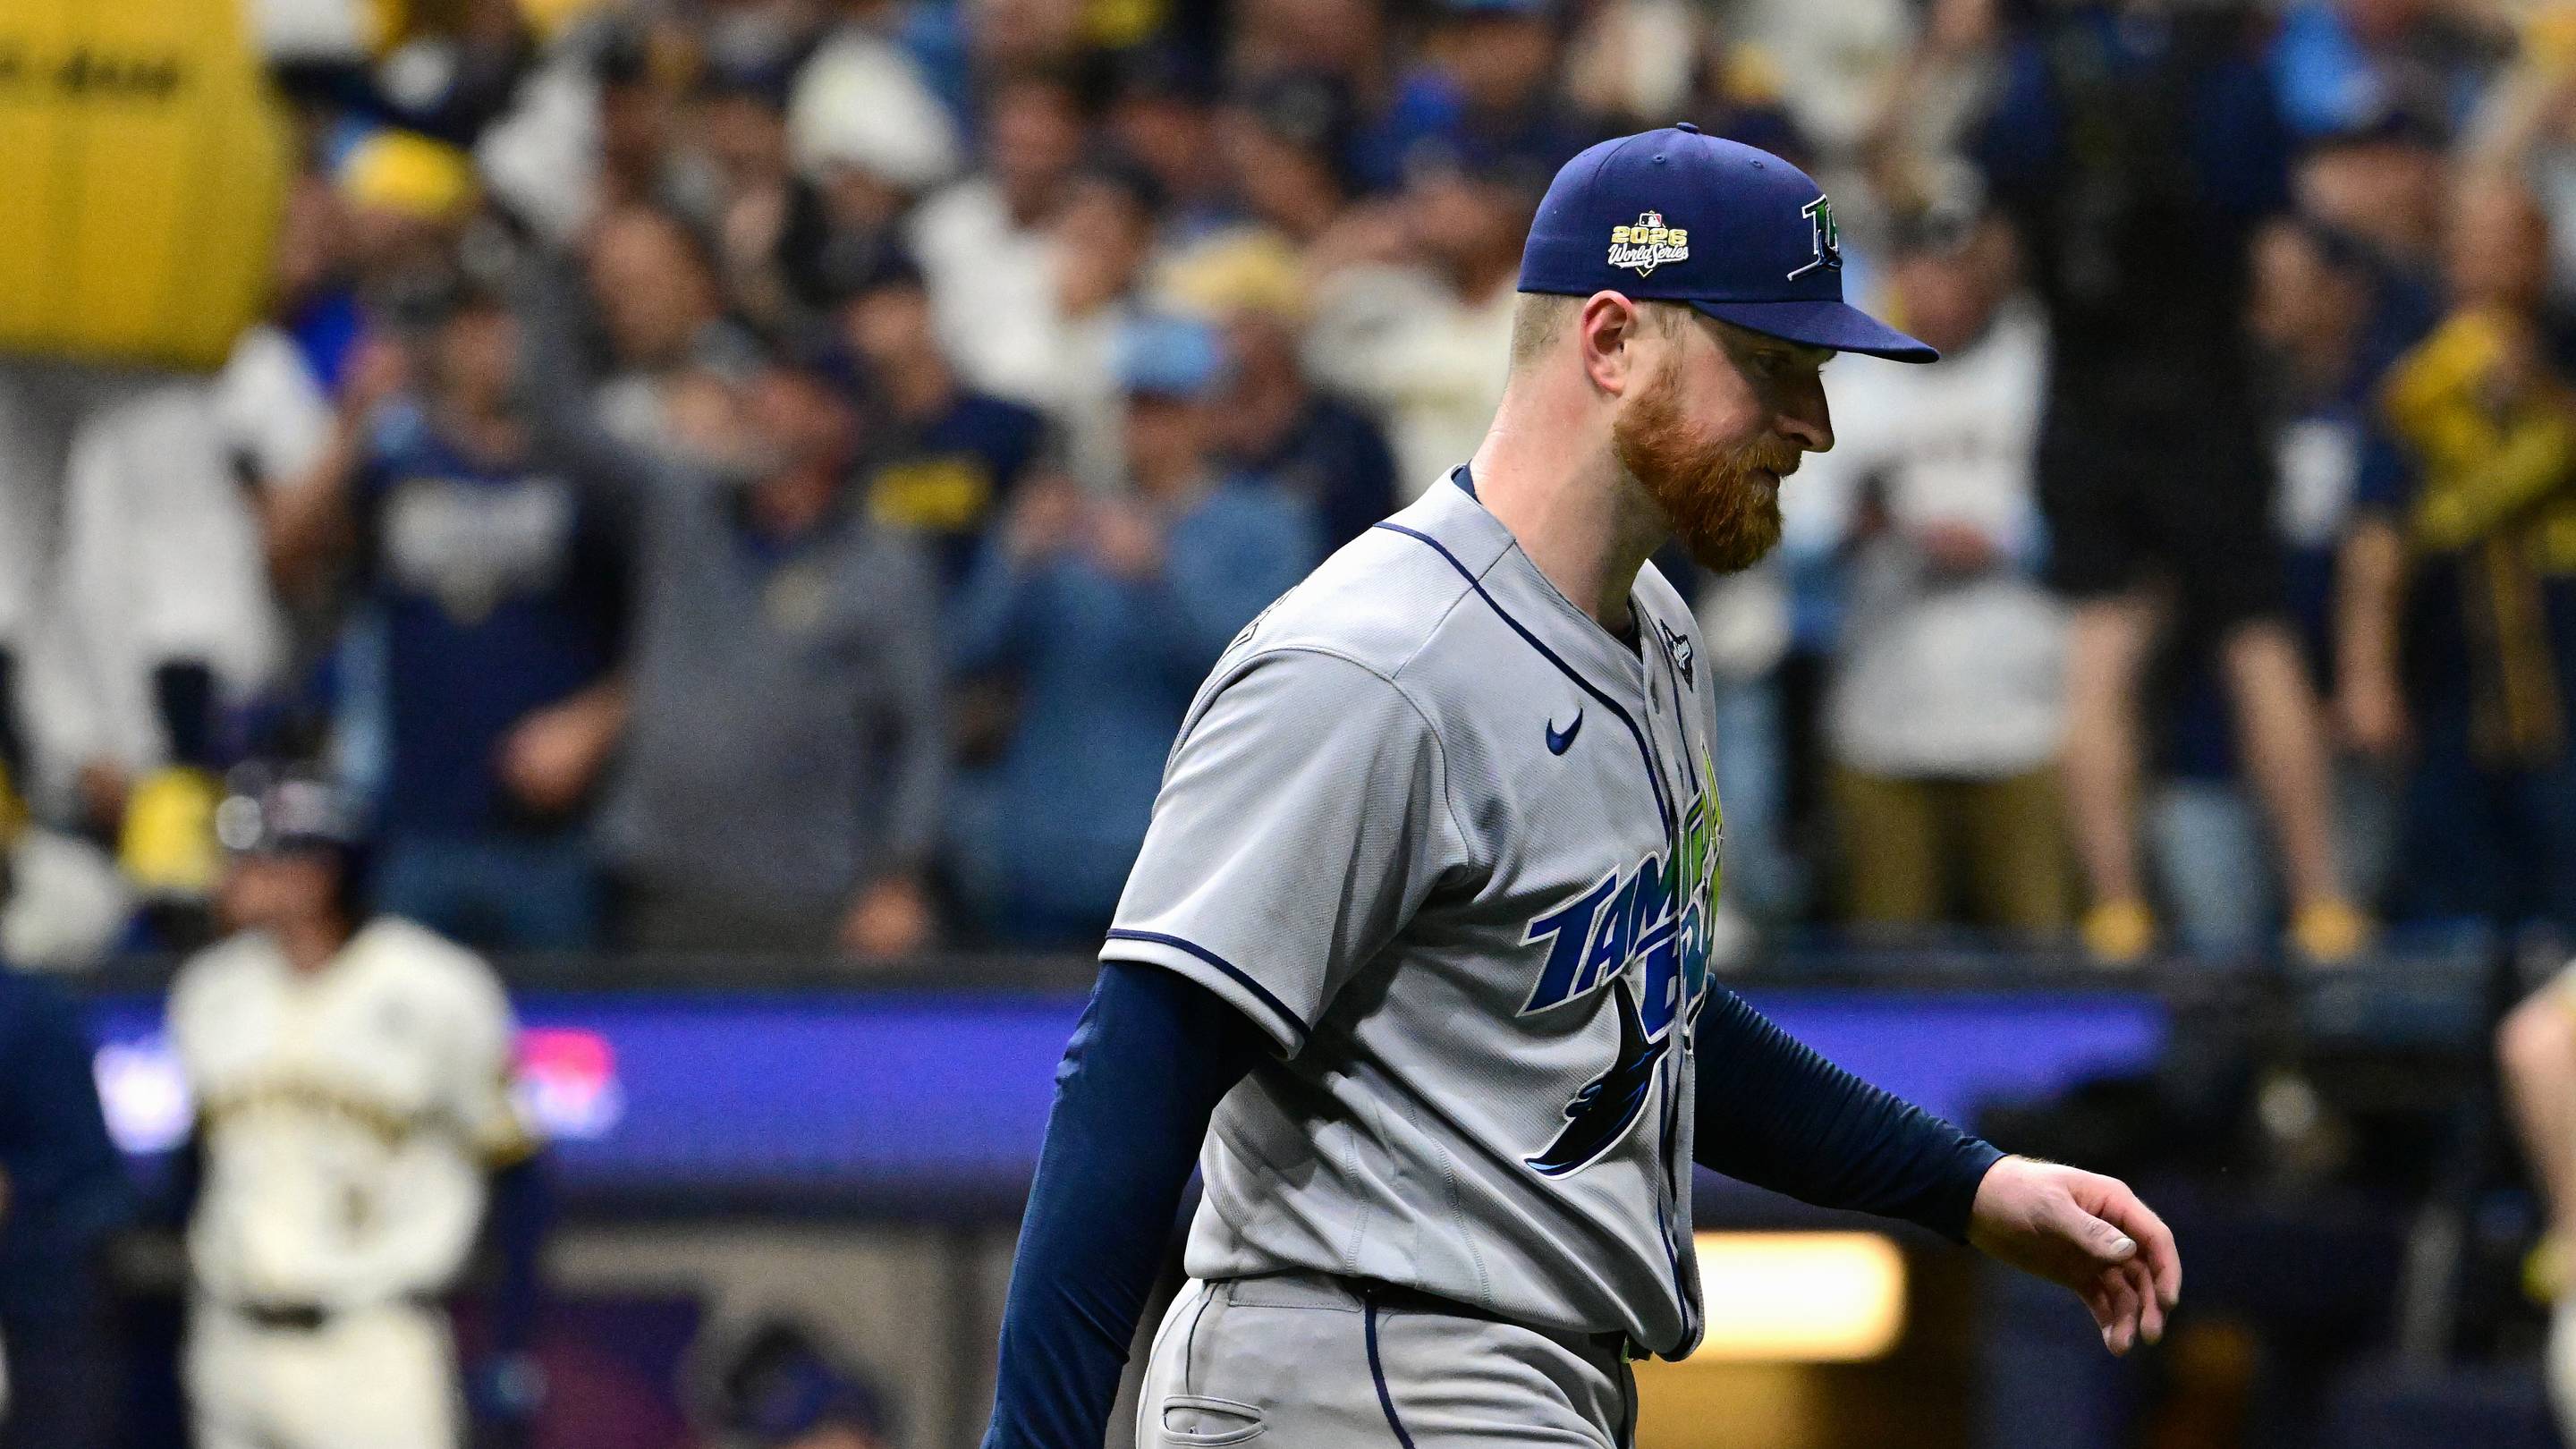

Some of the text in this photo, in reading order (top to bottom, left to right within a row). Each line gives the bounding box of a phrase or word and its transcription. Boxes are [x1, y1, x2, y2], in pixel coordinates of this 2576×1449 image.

[1611, 225, 1688, 247] 2026
[1607, 242, 1689, 268] World Series
